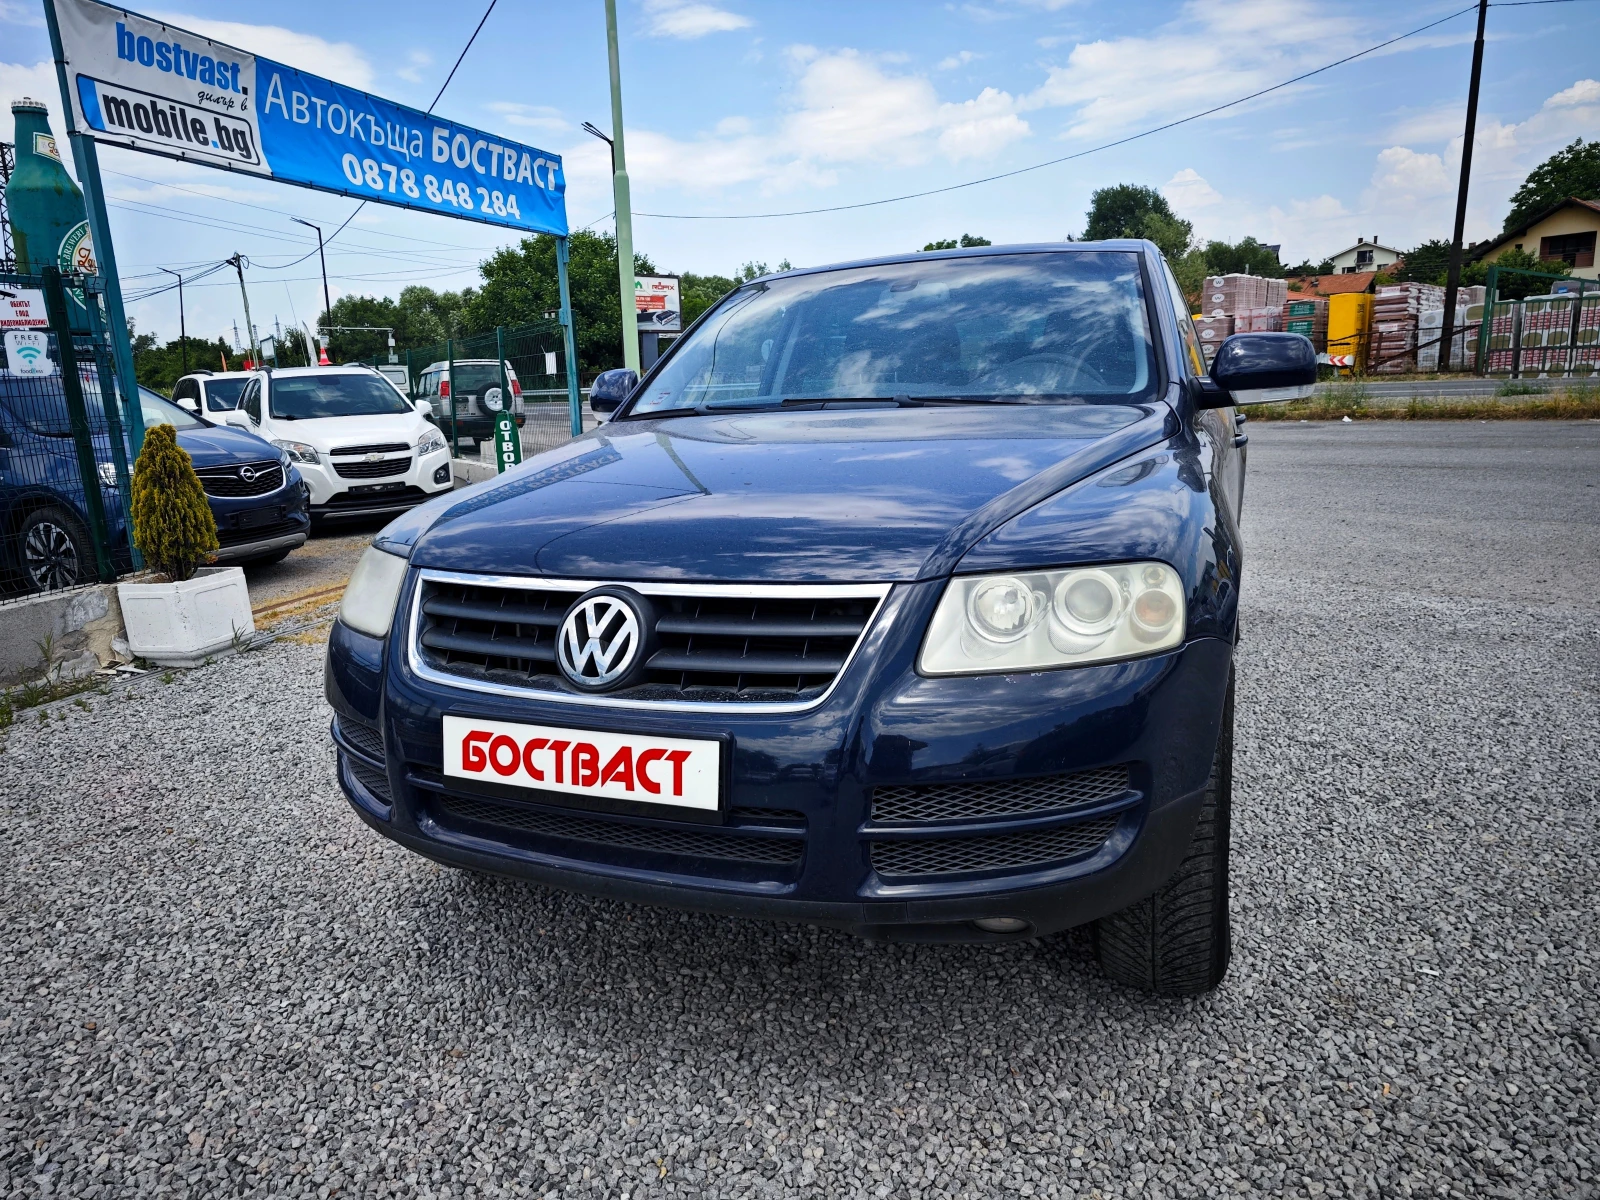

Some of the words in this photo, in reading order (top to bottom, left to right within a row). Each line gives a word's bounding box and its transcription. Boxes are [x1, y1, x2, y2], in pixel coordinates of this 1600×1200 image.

[102, 94, 252, 159] mobile.bg
[197, 91, 235, 111] дилър
[240, 97, 248, 111] в
[341, 152, 420, 199] 0878
[423, 174, 474, 210] 848
[476, 186, 521, 219] 284
[432, 126, 559, 190] БОСТВАСТ
[63, 227, 85, 261] BREWERY
[462, 730, 692, 796] БОСТВАСТ
